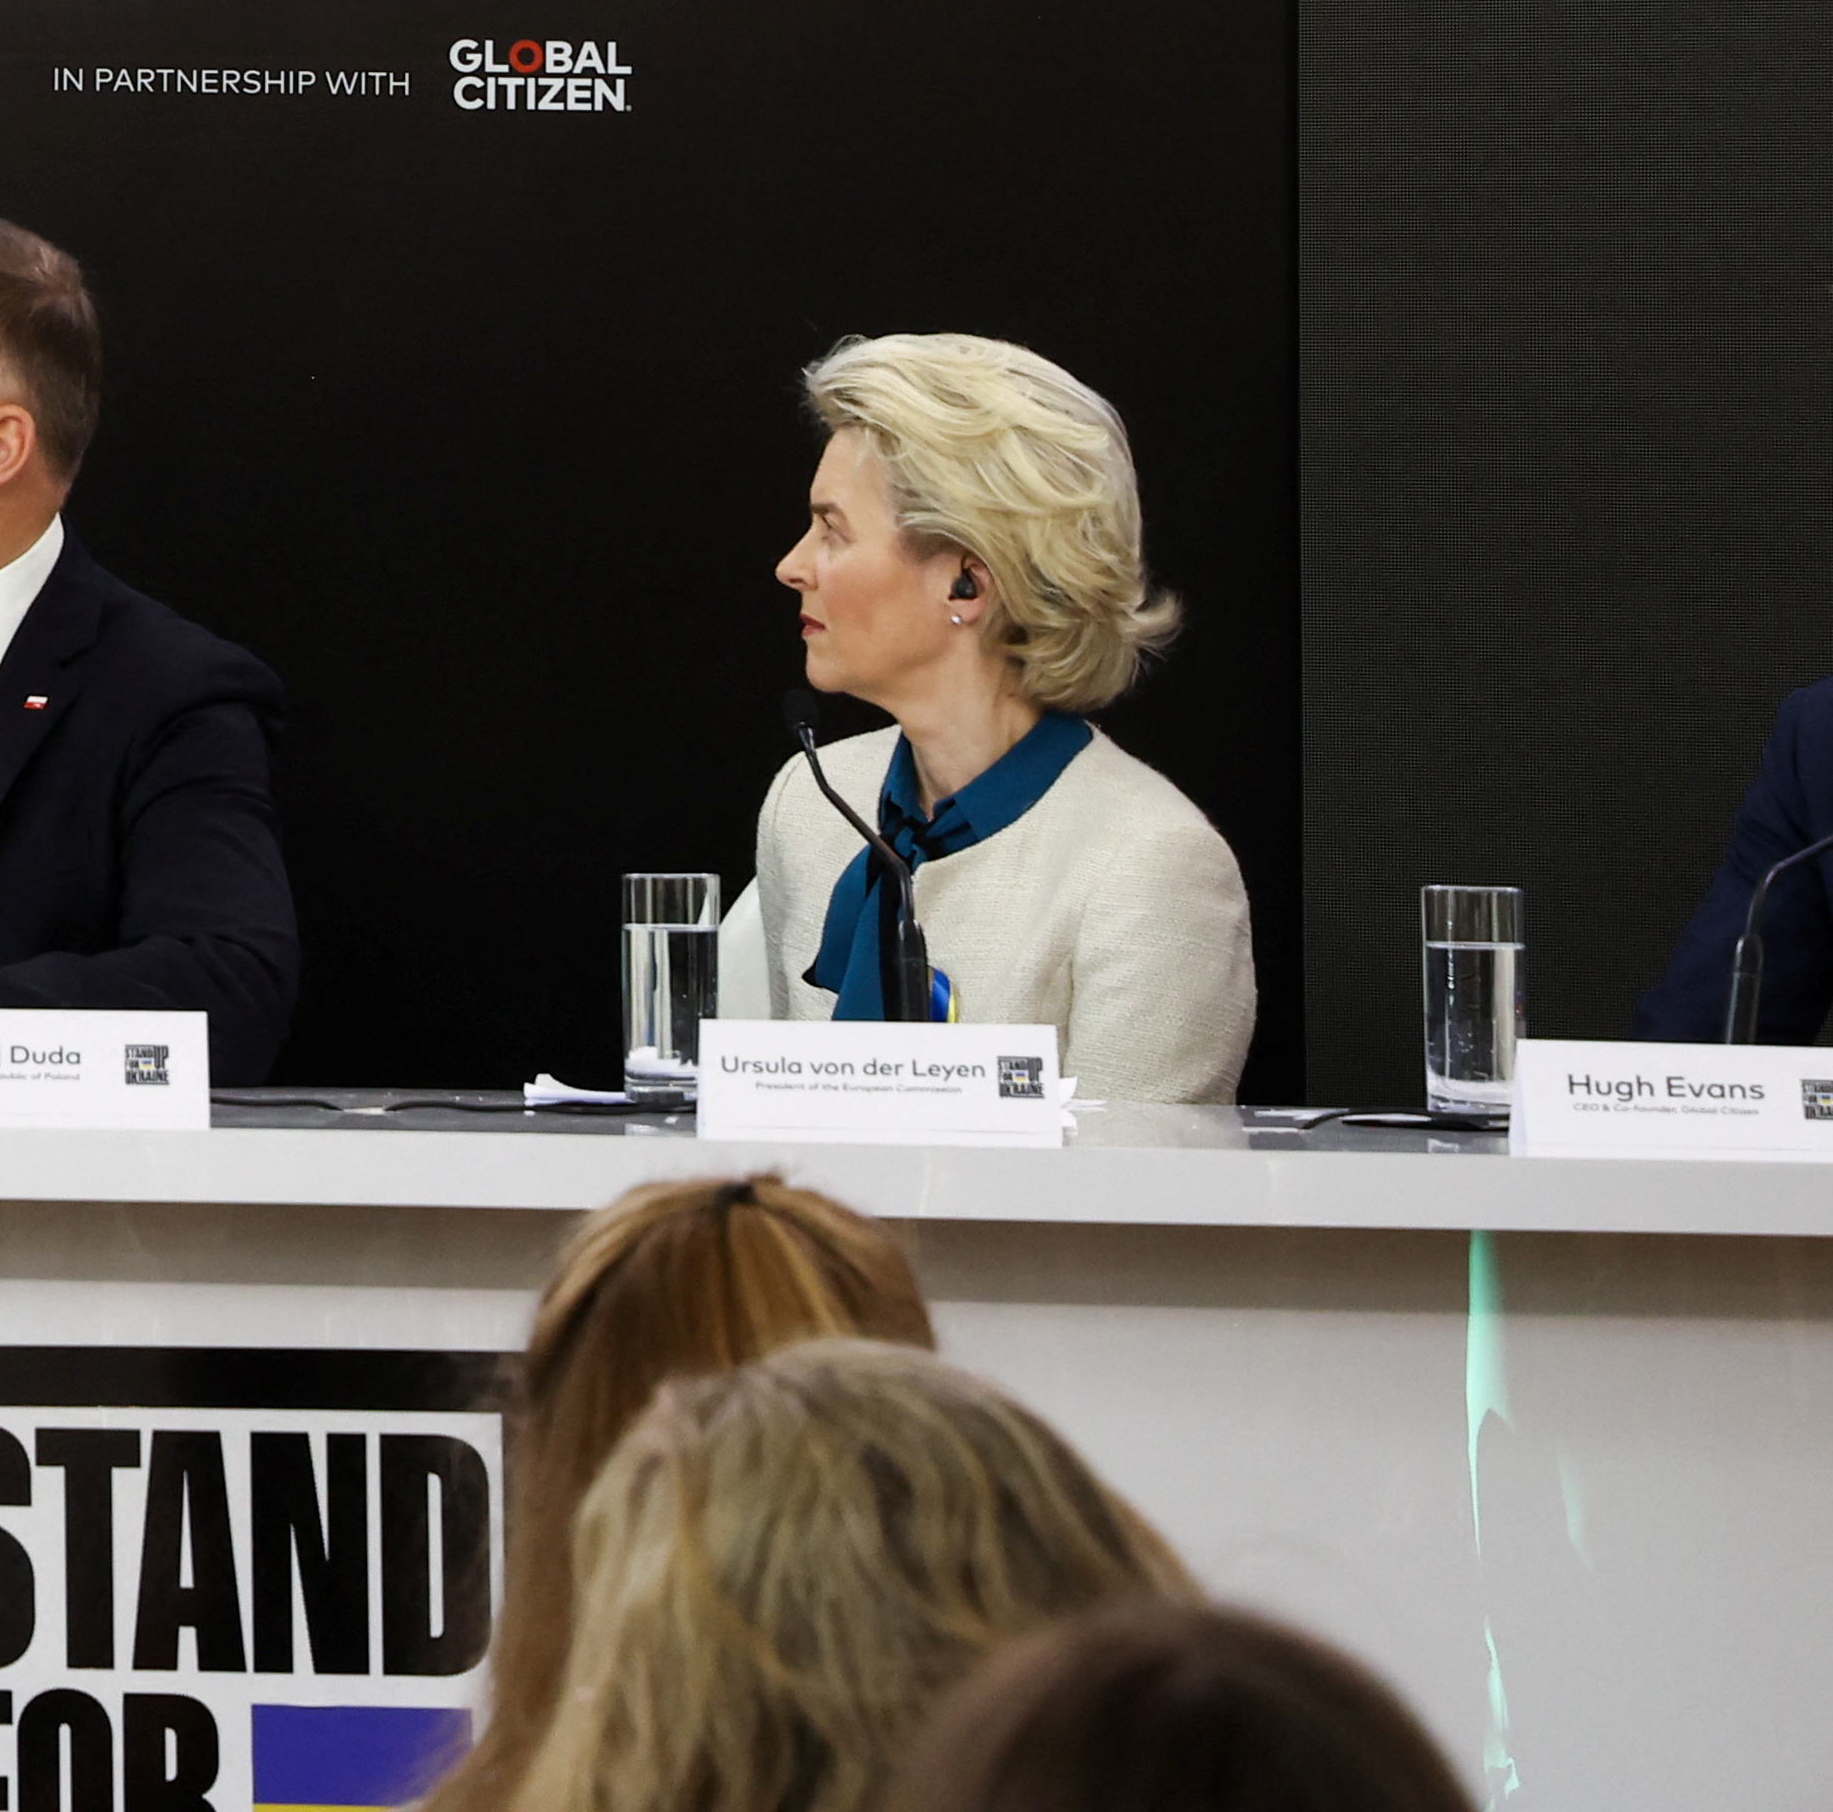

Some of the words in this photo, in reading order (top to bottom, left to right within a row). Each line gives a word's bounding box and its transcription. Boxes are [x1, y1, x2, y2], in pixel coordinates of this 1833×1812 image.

[449, 39, 632, 75] GLOBAL
[52, 67, 86, 92] IN
[94, 68, 316, 96] PARTNERSHIP
[326, 71, 410, 96] WITH
[453, 76, 632, 112] CITIZEN
[10, 1045, 82, 1065] Duda
[721, 1056, 801, 1075] Ursula
[810, 1060, 855, 1076] von
[863, 1058, 904, 1077] der
[912, 1060, 986, 1082] Leyen
[1568, 1074, 1654, 1102] Hugh
[1666, 1076, 1765, 1099] Evans
